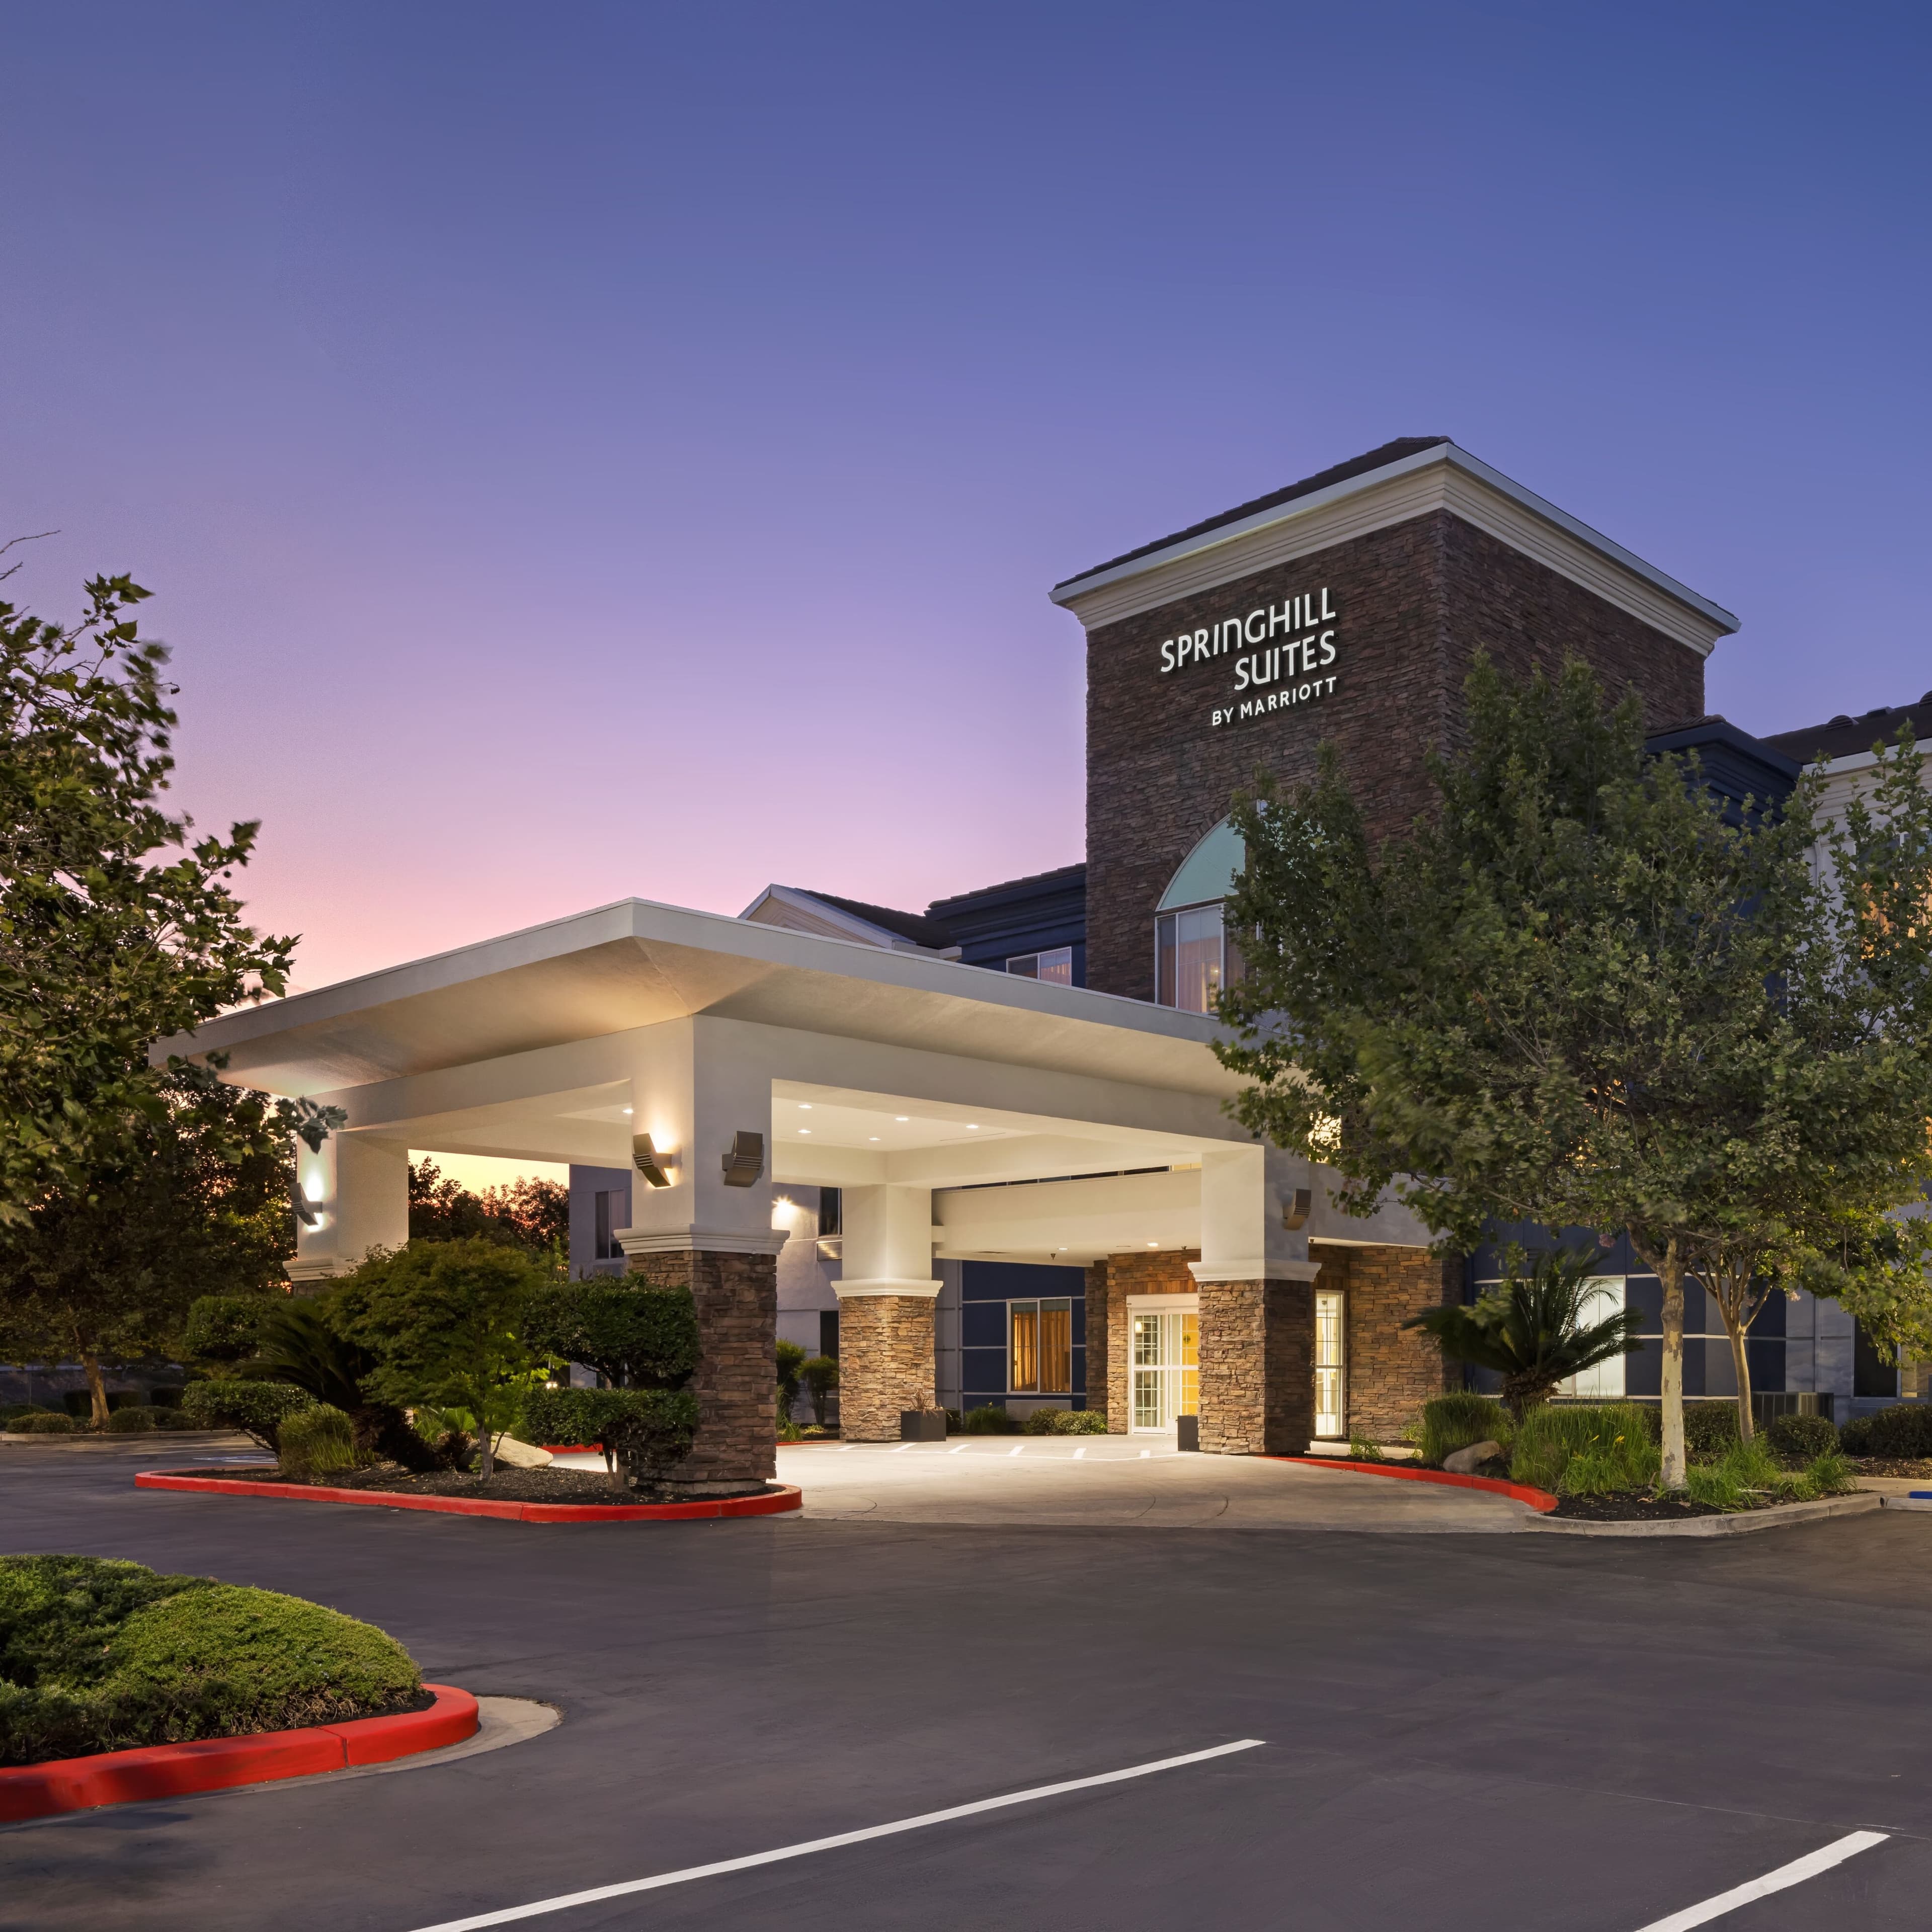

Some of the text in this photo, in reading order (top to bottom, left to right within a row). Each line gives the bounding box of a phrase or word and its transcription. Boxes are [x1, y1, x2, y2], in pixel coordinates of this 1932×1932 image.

[1160, 587, 1336, 673] SPRINGHILL
[1234, 630, 1336, 691] SUITES
[1212, 676, 1337, 726] BY MARRIOTT
